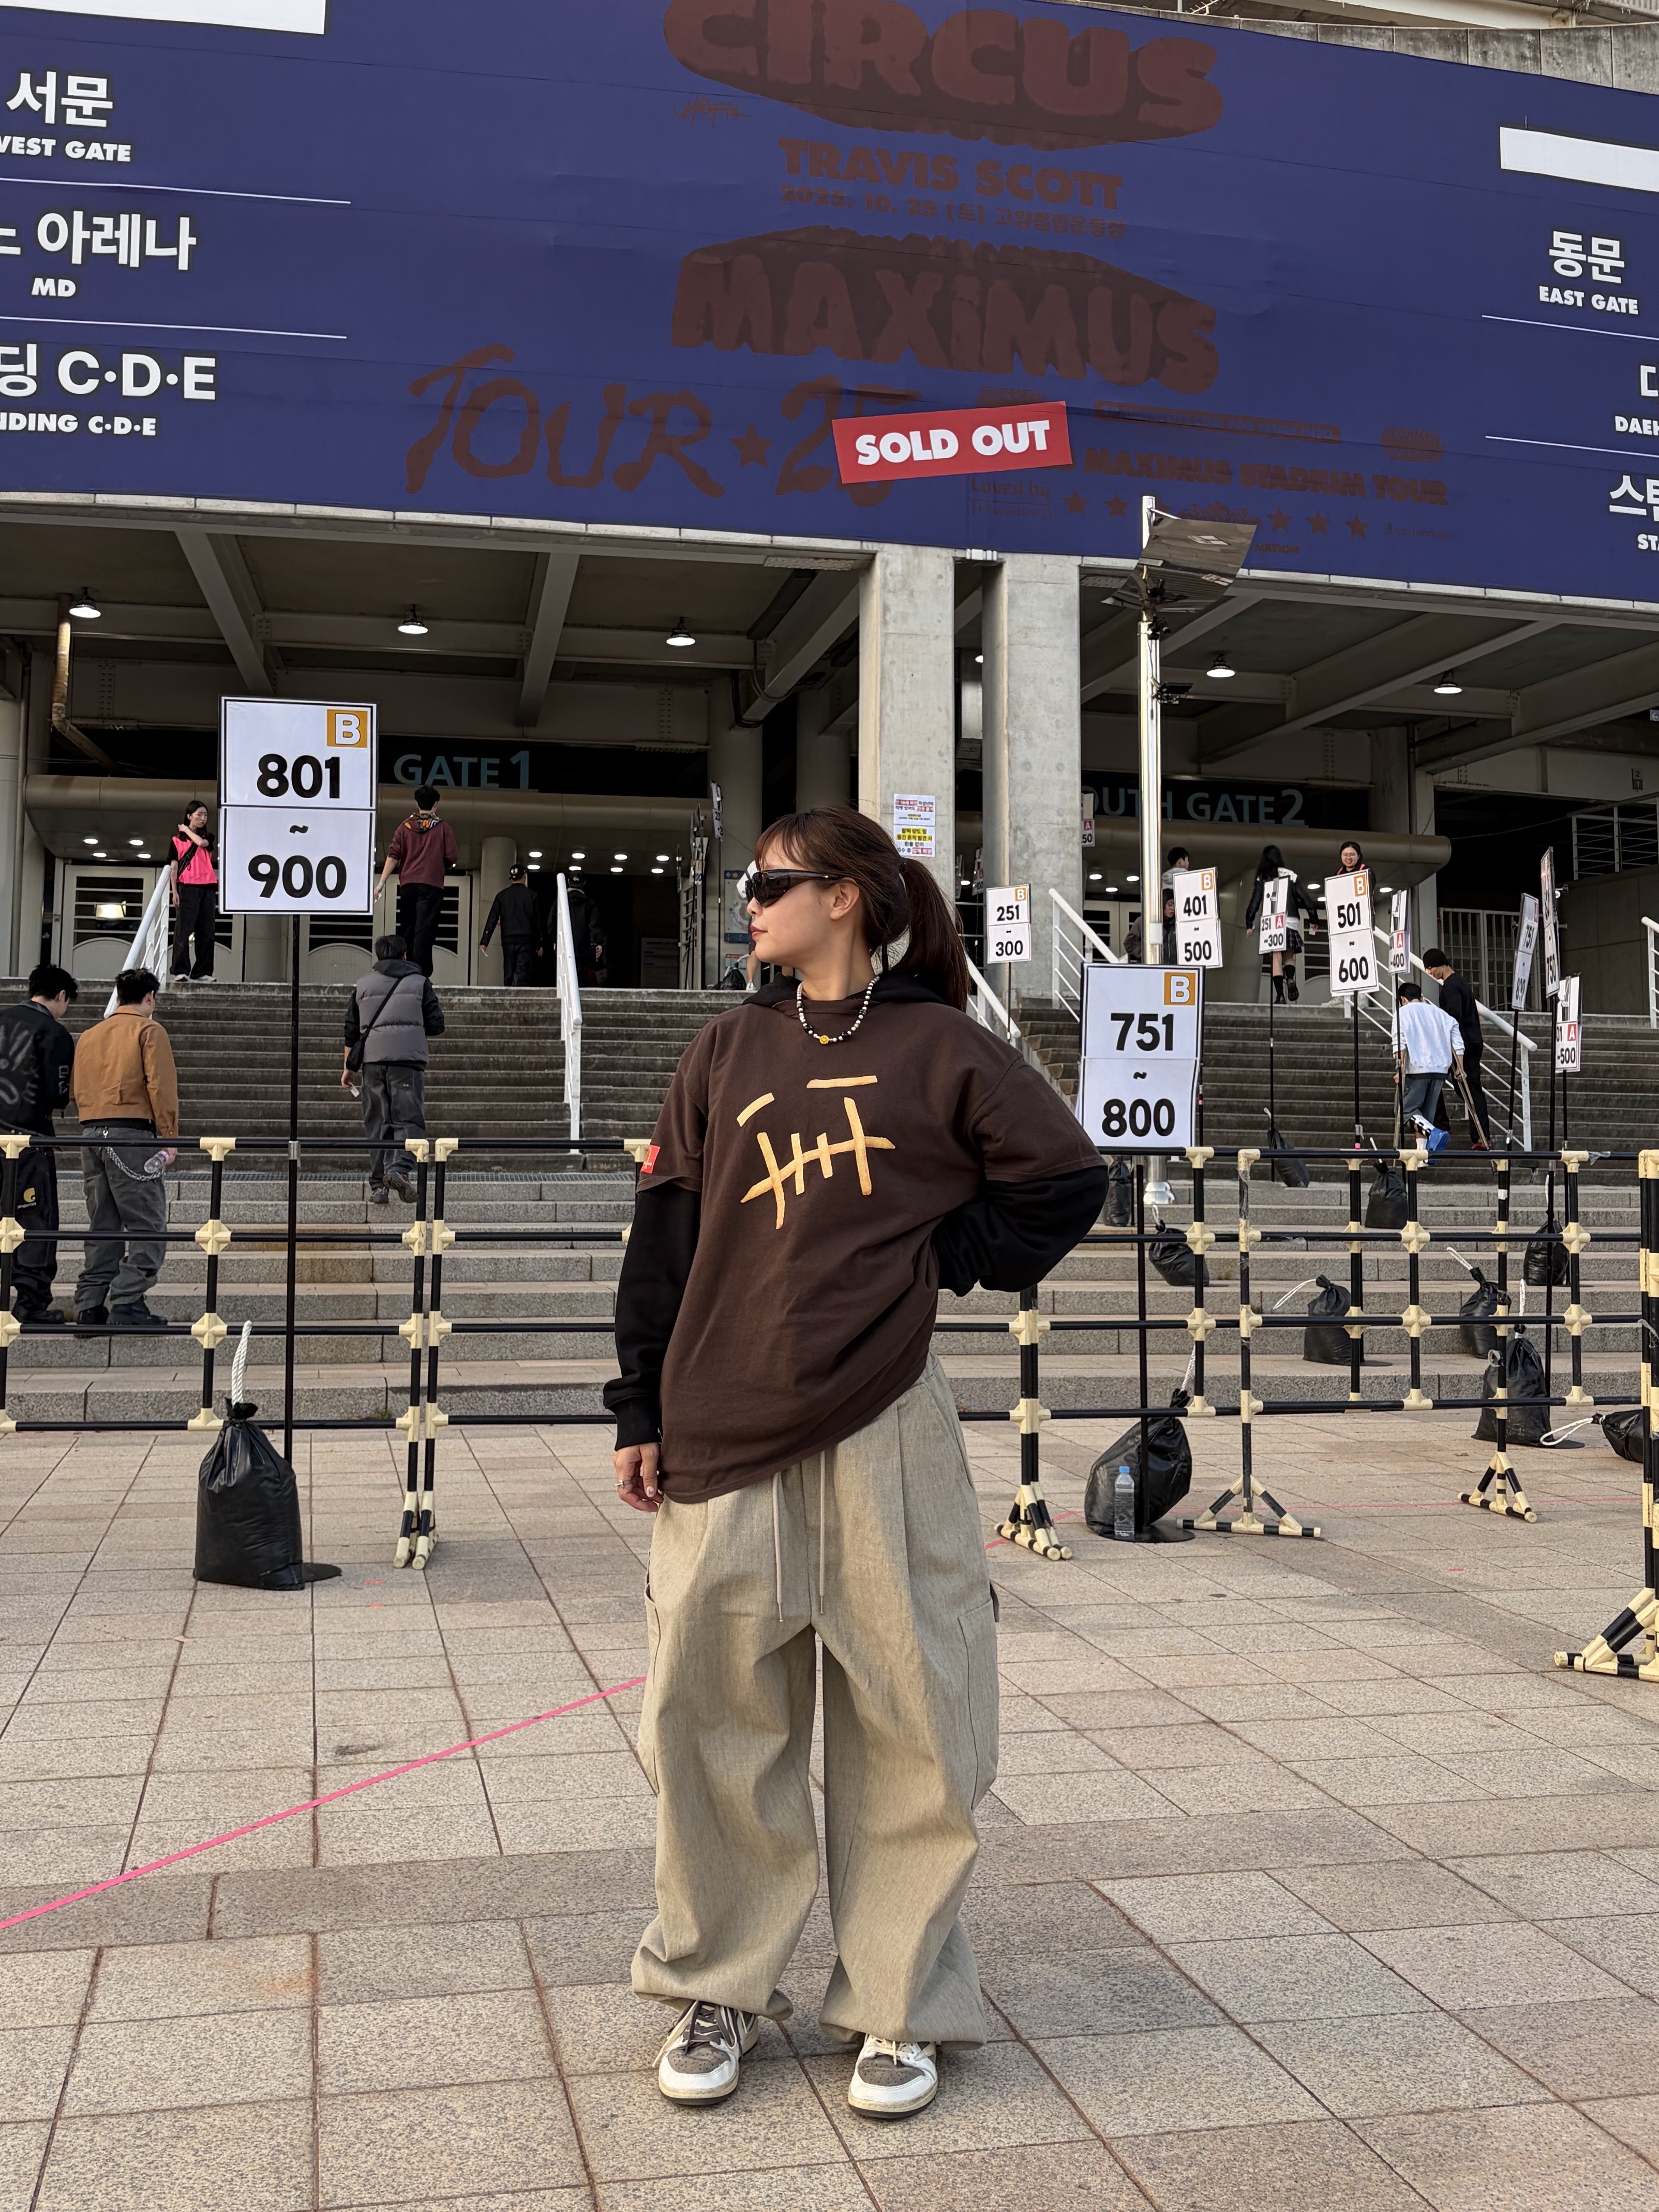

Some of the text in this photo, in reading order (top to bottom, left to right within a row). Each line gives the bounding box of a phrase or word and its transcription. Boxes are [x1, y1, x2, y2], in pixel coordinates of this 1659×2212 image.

[663, 0, 1223, 136] CIRCUS
[6, 71, 113, 127] 서문
[65, 141, 131, 162] GATE
[778, 137, 1124, 210] TRAVIS SCOTT
[779, 184, 854, 209] 2025.
[863, 194, 898, 214] 10.
[905, 199, 937, 217] 25
[37, 211, 197, 271] 아레나
[1549, 231, 1625, 284] 동문
[32, 277, 76, 297] MD
[1539, 286, 1639, 315] EAST GATE
[405, 344, 725, 498] TOUR
[855, 420, 1050, 466] SOLD OUT
[1084, 448, 1232, 486] MAXIMUS
[1240, 461, 1367, 498] STADIUM
[1373, 475, 1449, 506] TOUR
[335, 714, 361, 745] B
[257, 753, 340, 799] 801
[394, 751, 530, 790] GATE 1
[1186, 792, 1275, 824] GATE
[1281, 789, 1305, 826] 2
[248, 854, 347, 899] 900
[1204, 874, 1212, 889] B
[1355, 875, 1366, 896] B
[1017, 889, 1026, 900] B
[1183, 895, 1207, 917] 401
[997, 904, 1020, 922] 251
[1261, 917, 1272, 931] 251
[1337, 901, 1362, 929] 501
[995, 940, 1023, 957] 300
[1184, 940, 1212, 962] 500
[1338, 956, 1369, 983] 600
[1170, 975, 1190, 1003] B
[1110, 1013, 1174, 1051] 751
[1102, 1098, 1175, 1138] 800
